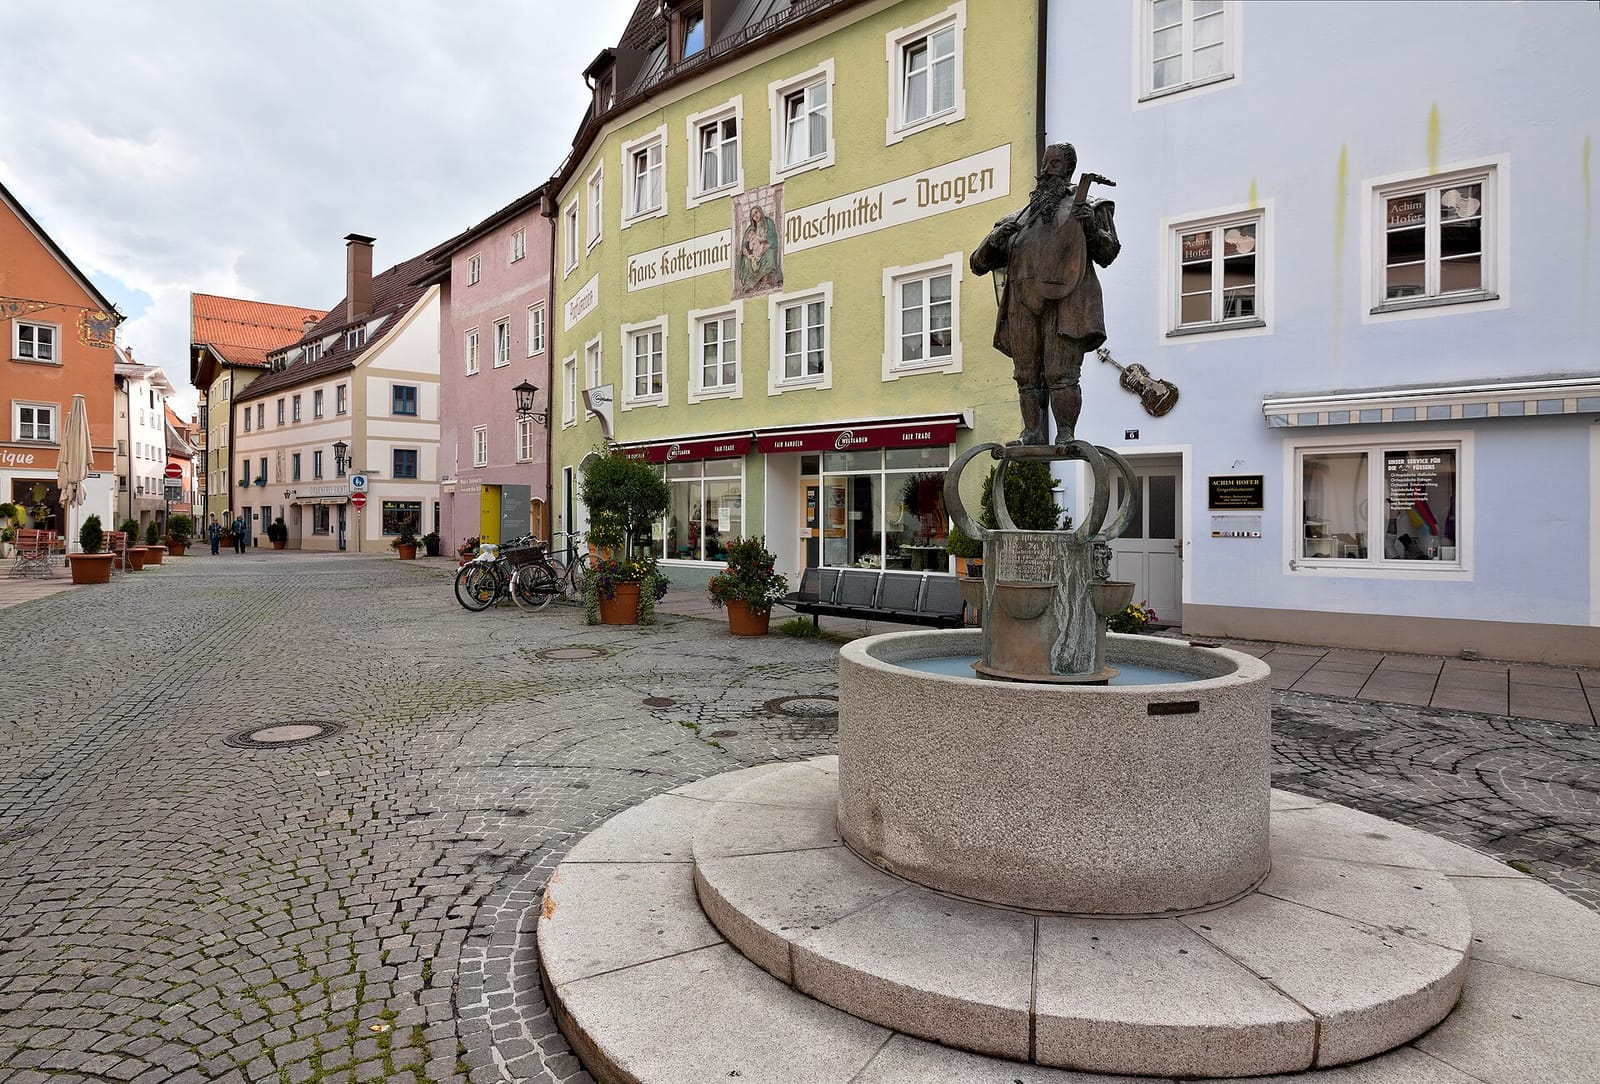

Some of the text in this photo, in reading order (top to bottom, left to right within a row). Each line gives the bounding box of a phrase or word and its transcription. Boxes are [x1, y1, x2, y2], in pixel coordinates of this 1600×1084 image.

[785, 191, 883, 245] Waschmittel
[916, 167, 994, 208] Drogen
[1391, 202, 1422, 213] Achim
[1391, 213, 1423, 225] Hofer
[1184, 239, 1210, 249] Achim
[1185, 248, 1210, 259] Hofer
[628, 236, 731, 287] Hans Kottermair
[841, 437, 868, 445] WELTLADEN
[902, 432, 931, 441] FAIR TRADE
[784, 440, 803, 448] HANDELN
[0, 450, 34, 467] ique
